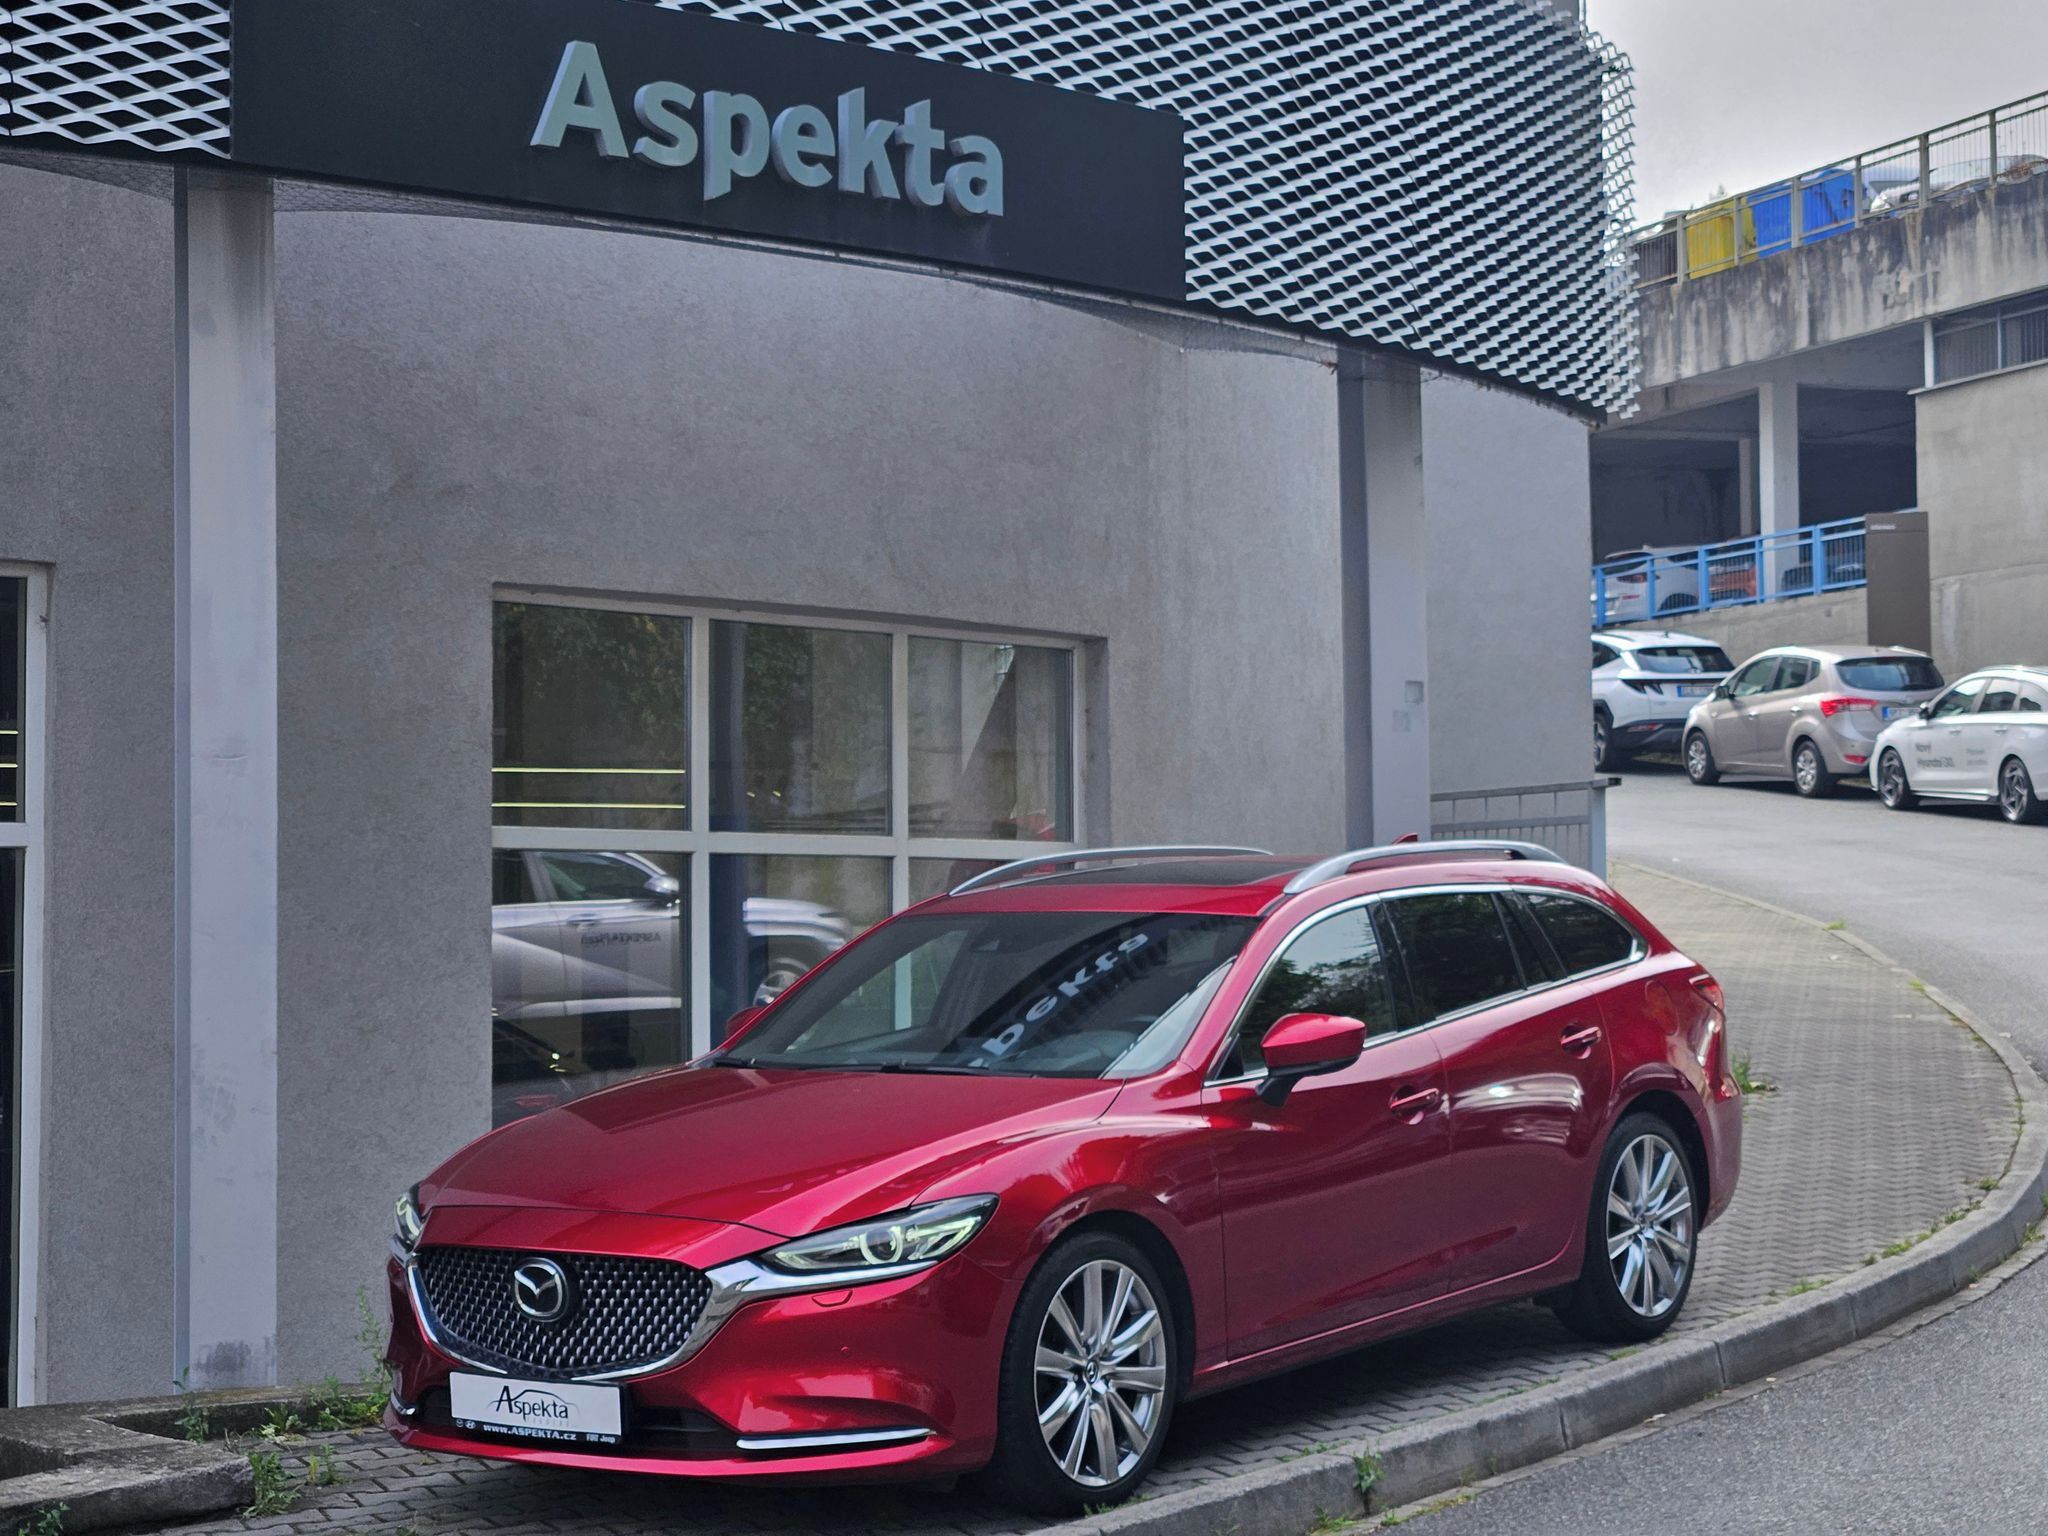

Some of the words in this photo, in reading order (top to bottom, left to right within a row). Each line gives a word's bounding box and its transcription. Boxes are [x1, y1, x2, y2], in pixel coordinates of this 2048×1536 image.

[530, 40, 1004, 217] Aspekta
[495, 1385, 569, 1421] Aspekta
[483, 1423, 577, 1441] www.ASPEKTA.cz
